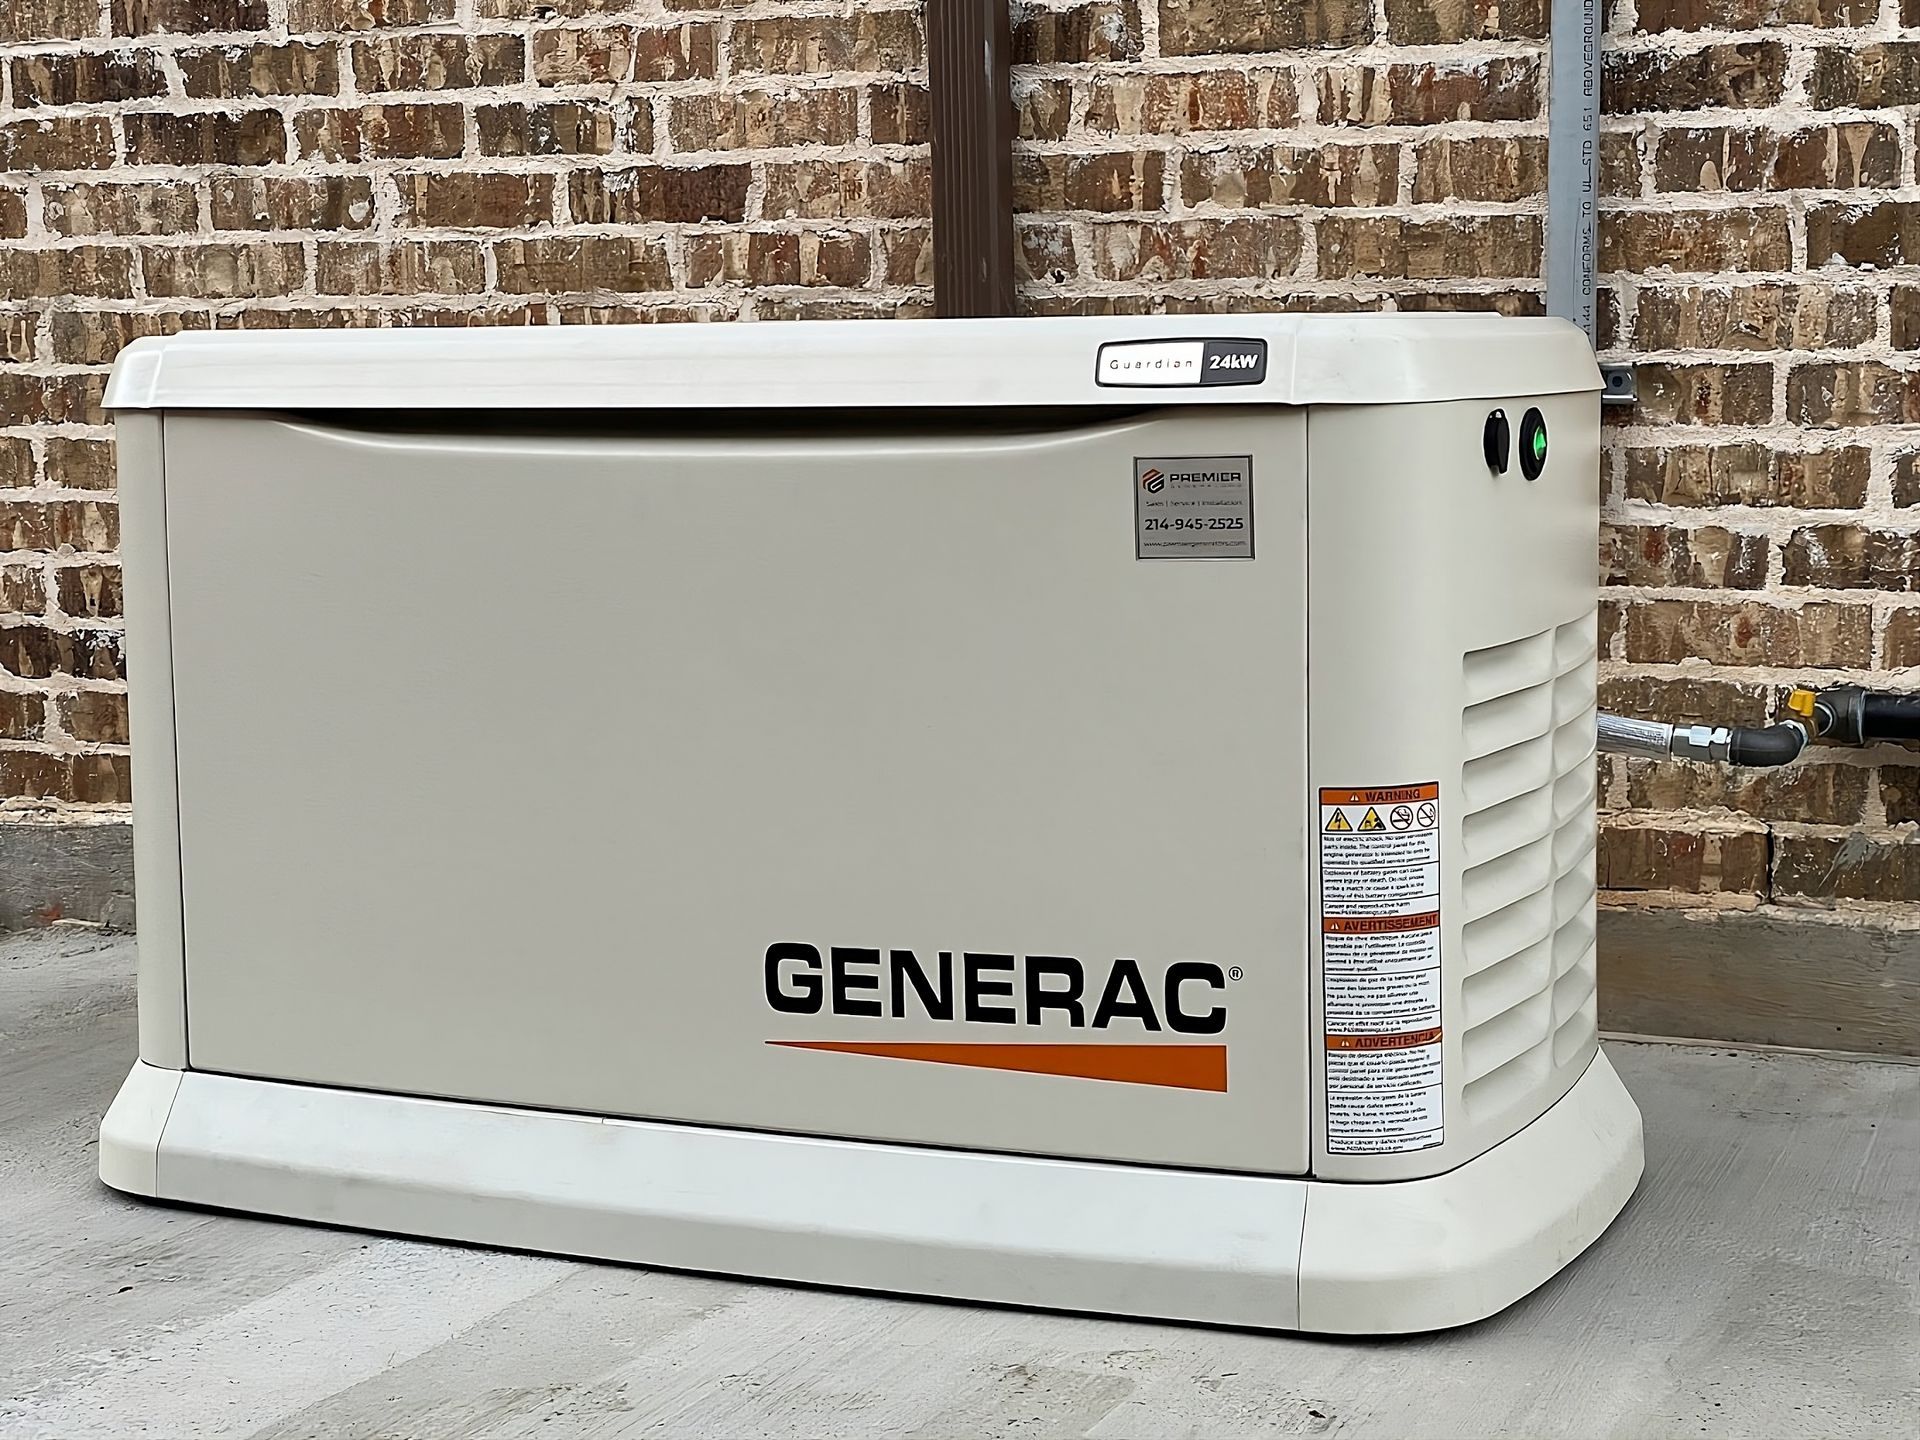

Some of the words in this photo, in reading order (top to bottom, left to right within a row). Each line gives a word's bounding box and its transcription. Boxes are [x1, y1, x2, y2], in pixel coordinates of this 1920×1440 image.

[1583, 0, 1593, 97] ABOVEGROUND
[1582, 107, 1593, 131] 651
[1582, 140, 1592, 166] STD
[1582, 174, 1592, 193] UL
[1582, 201, 1592, 218] TO
[1582, 223, 1592, 296] CONFORMS
[1582, 304, 1591, 336] 144
[1109, 359, 1193, 370] Guardian
[1209, 353, 1259, 370] 24kW
[1169, 472, 1241, 483] PREMIER
[1144, 517, 1244, 531] 214-945-2525
[1365, 788, 1421, 802] WARNING
[1343, 914, 1438, 931] AVERTISSEMENT
[1354, 1031, 1434, 1047] ADVERTENCIA
